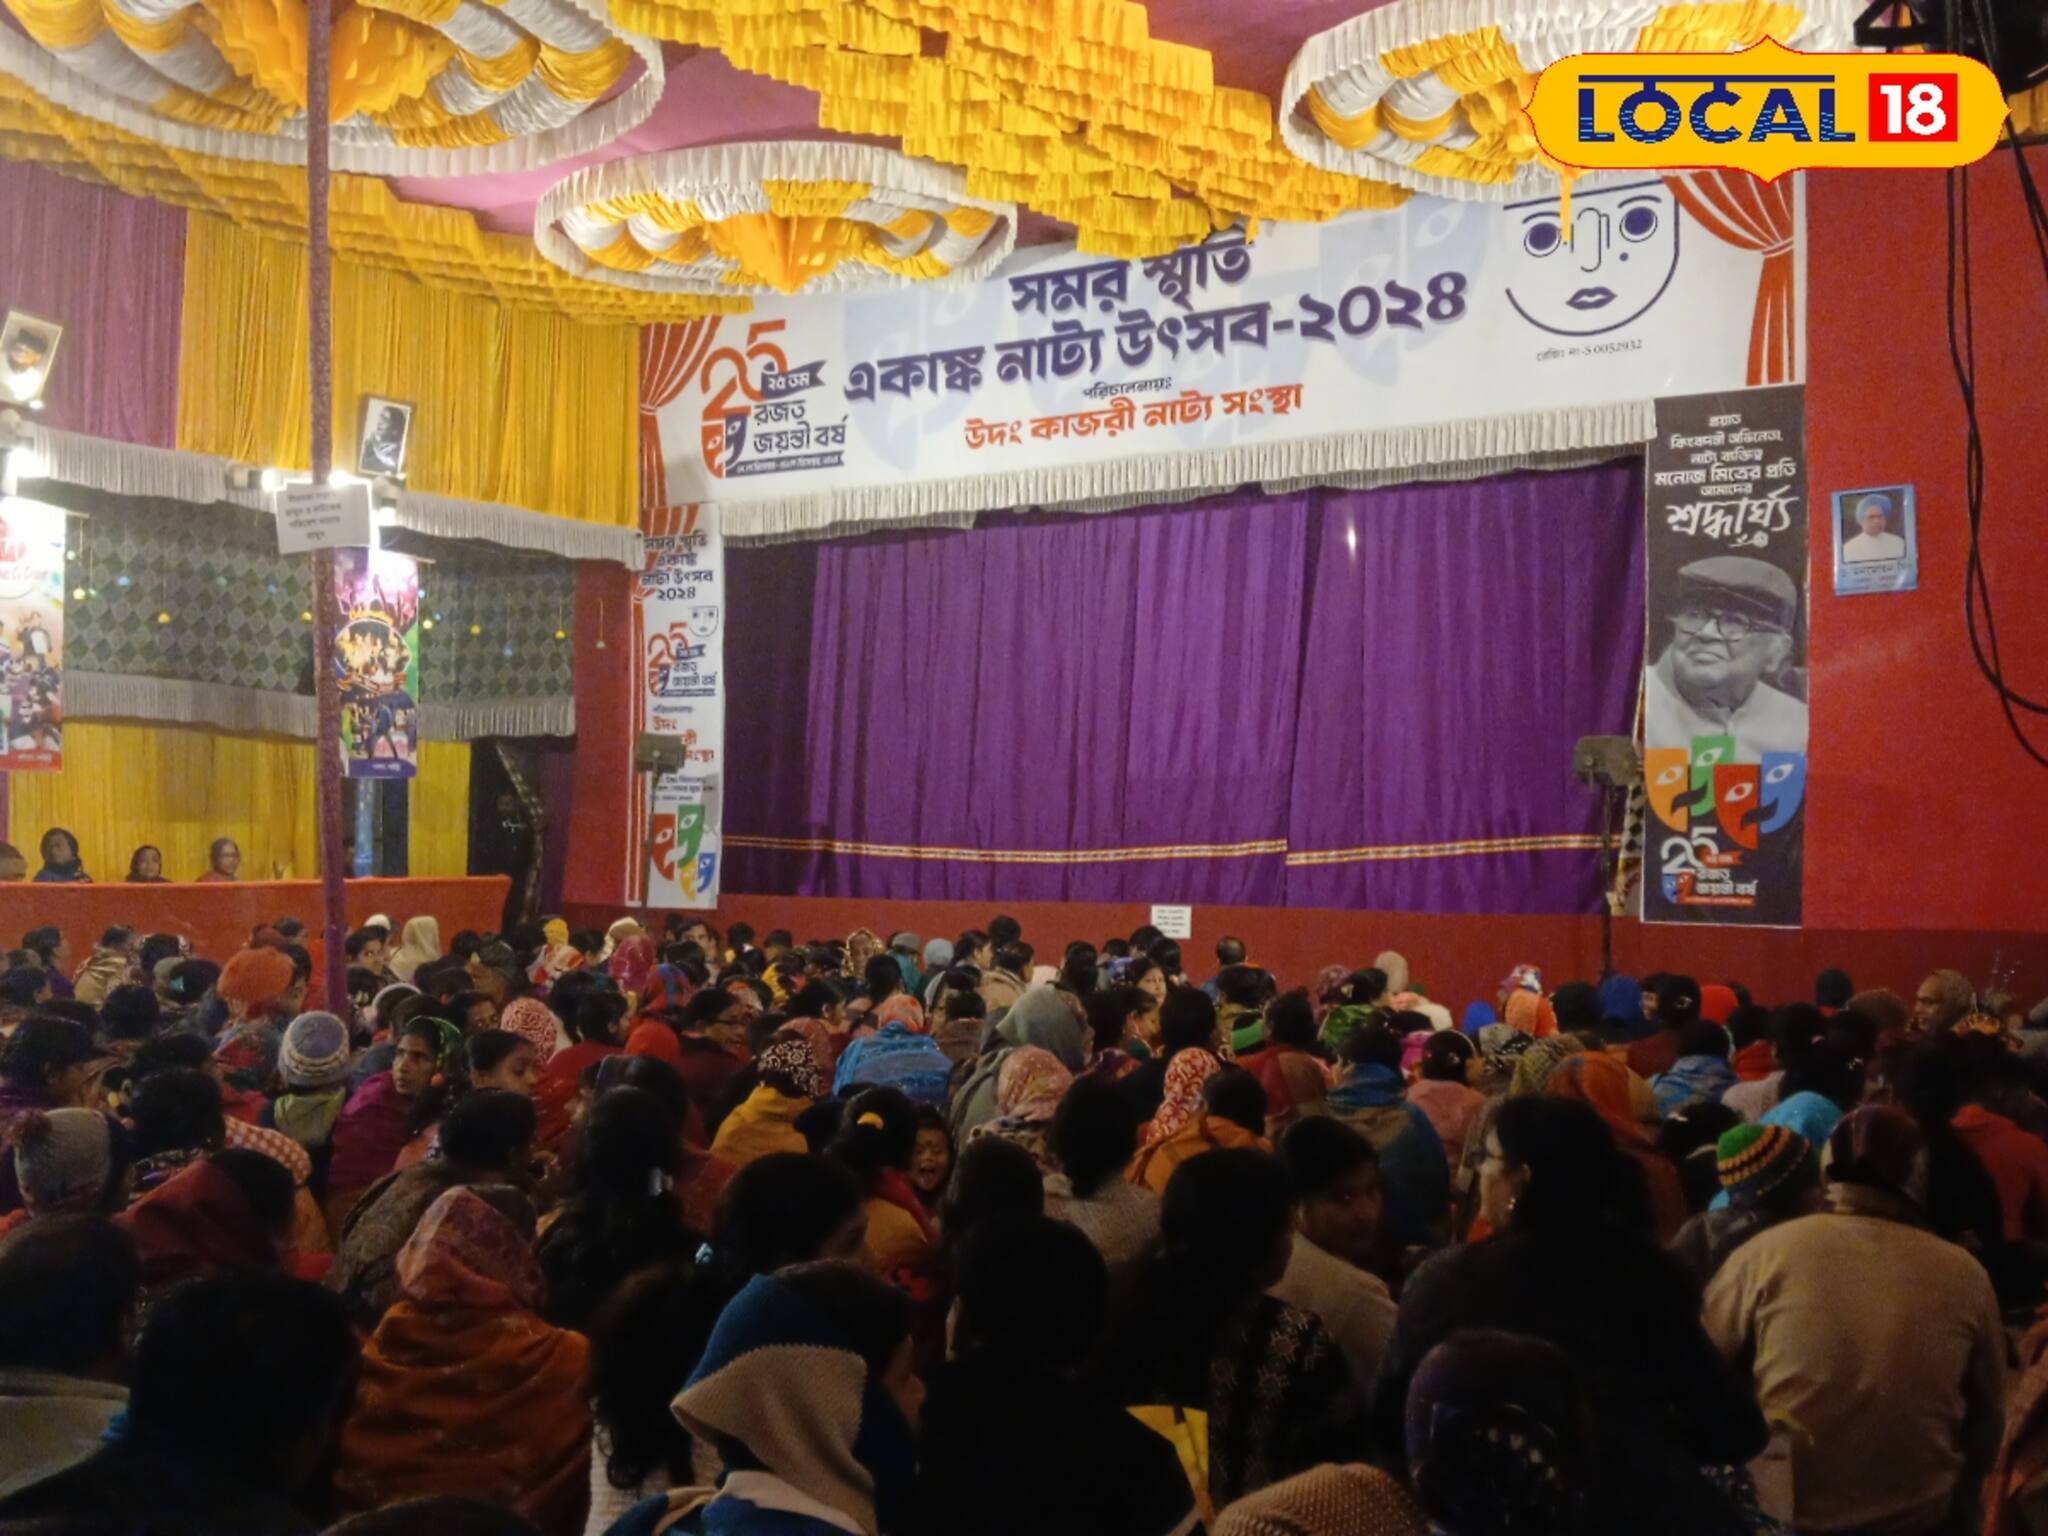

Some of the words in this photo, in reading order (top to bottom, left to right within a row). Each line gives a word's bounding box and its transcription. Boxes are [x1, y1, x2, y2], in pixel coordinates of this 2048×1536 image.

[1009, 258, 1132, 314] সমর
[844, 345, 987, 403] একাঙ্ক
[994, 319, 1106, 383] নাট্য
[753, 399, 806, 426] রজত
[964, 417, 1023, 450] উদং
[1030, 396, 1137, 440] কাজরী
[1143, 389, 1215, 427] নাট্য
[1222, 382, 1304, 417] সংস্থা
[753, 420, 811, 454] জয়ন্তী
[814, 414, 848, 446] বর্ষ
[1654, 469, 1706, 486] মনোজ
[1711, 462, 1761, 482] মিত্রের
[1765, 457, 1796, 478] প্রতি
[656, 586, 696, 601] ২০২৪
